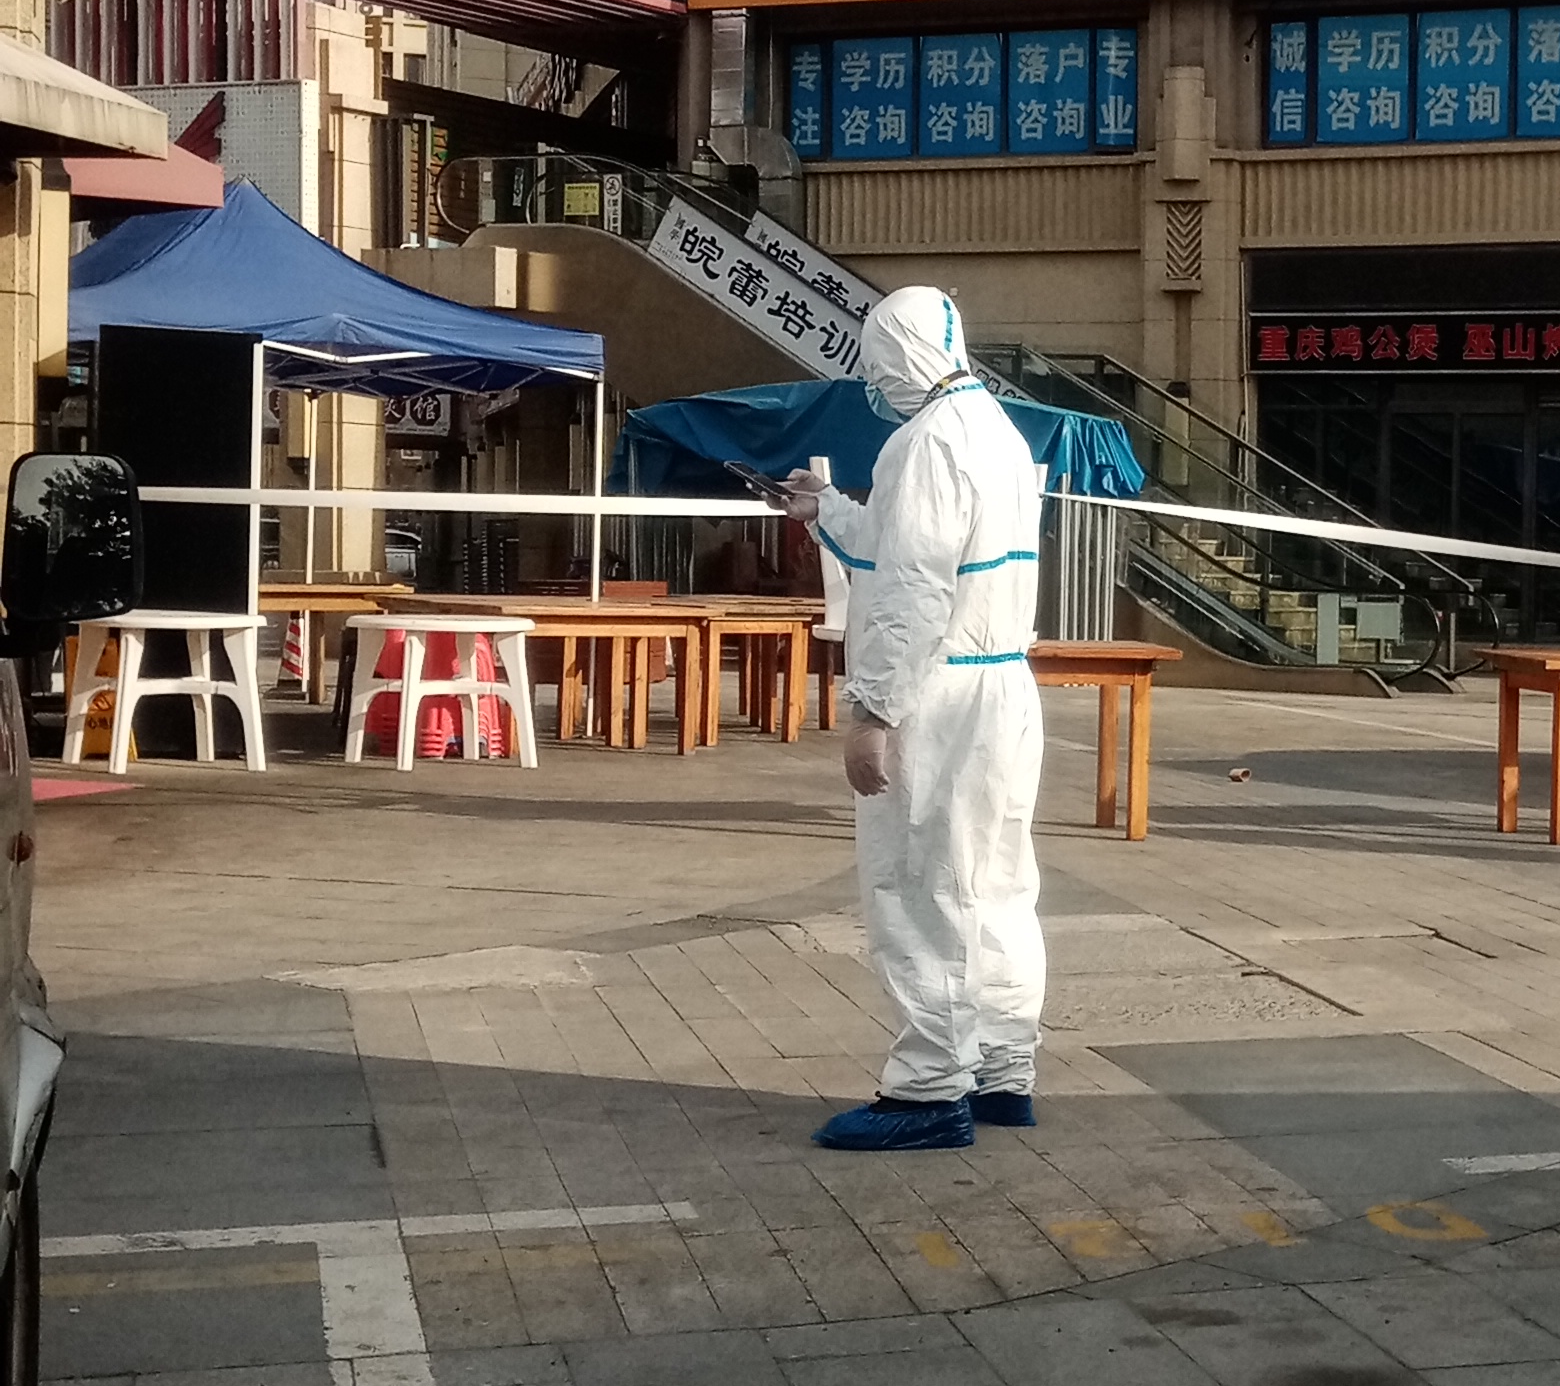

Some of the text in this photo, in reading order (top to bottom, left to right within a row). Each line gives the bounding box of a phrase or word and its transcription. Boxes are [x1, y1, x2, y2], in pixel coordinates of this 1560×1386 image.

[1017, 42, 1085, 85] 落户
[1326, 28, 1401, 73] 学历
[1425, 23, 1502, 68] 积分
[841, 49, 907, 93] 学历
[927, 46, 996, 89] 积分
[840, 104, 907, 146] 咨询
[927, 100, 995, 143] 咨询
[1016, 98, 1085, 140] 咨询
[1326, 87, 1401, 132] 咨询
[1424, 83, 1501, 128] 咨询
[1257, 324, 1439, 362] 重庆鸡公煲
